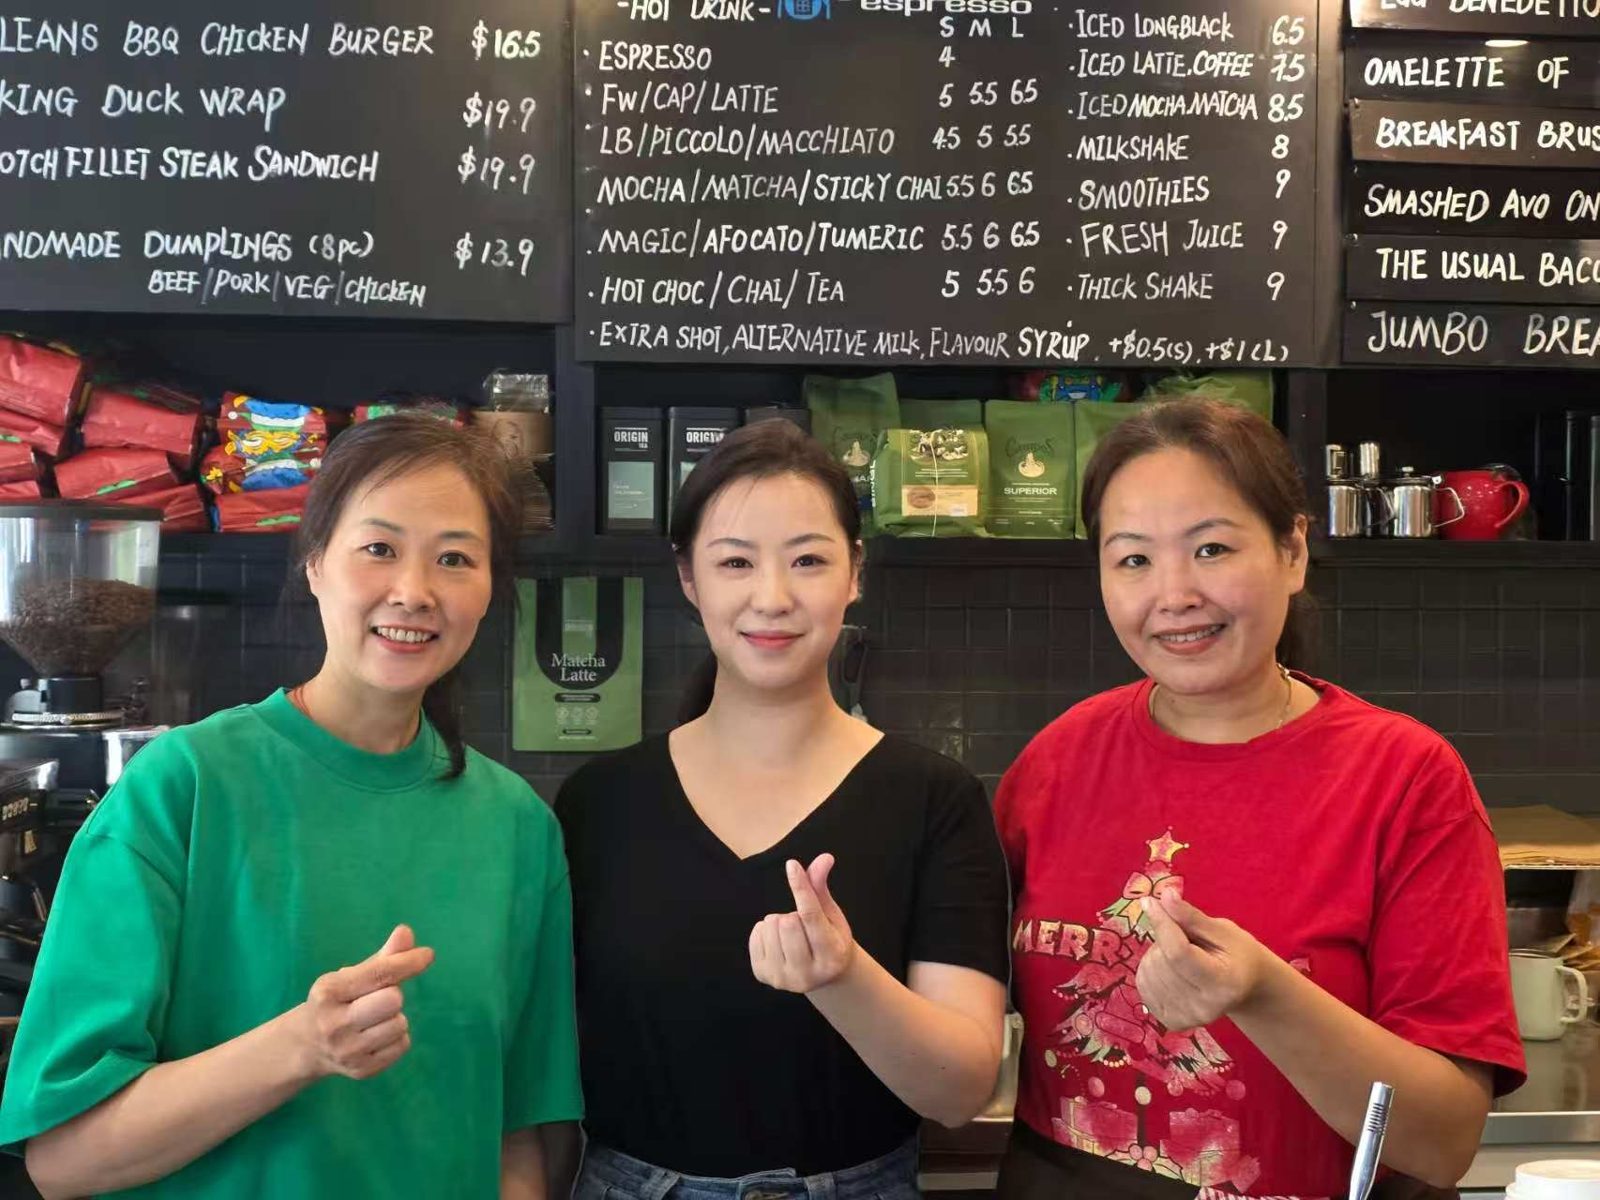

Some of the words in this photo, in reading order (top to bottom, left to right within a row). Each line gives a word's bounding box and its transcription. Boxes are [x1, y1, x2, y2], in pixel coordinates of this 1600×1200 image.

[860, 0, 1032, 16] espresso
[1076, 9, 1125, 38] ICED
[0, 17, 98, 56] LEANS
[123, 20, 179, 56] BBQ
[201, 22, 309, 56] CHICKEN
[328, 22, 434, 56] BURGER
[472, 20, 541, 60] $16.5
[939, 16, 955, 38] S
[969, 18, 992, 37] M
[1012, 17, 1024, 38] L
[599, 40, 712, 71] ESPRESSO
[938, 46, 956, 67] 4
[1077, 49, 1125, 78] ICED
[1364, 56, 1505, 87] OMELETTE
[1537, 56, 1570, 89] OF
[0, 79, 78, 118] KING
[102, 83, 184, 117] DUCK
[200, 86, 286, 132] WRAP
[463, 92, 536, 133] $19.9
[938, 83, 954, 108] 5
[1077, 91, 1127, 120] ICED
[1267, 94, 1304, 122] 8.5
[976, 125, 993, 148] 5
[1076, 133, 1190, 161] MILKSHAKE
[1271, 134, 1289, 159] 8
[1376, 117, 1521, 150] BREAKFAST
[0, 148, 59, 180] OTCH
[64, 146, 151, 180] FILLET
[159, 147, 239, 179] STEAK
[248, 145, 379, 182] SANDWICH
[458, 146, 536, 194] $19.9
[896, 175, 942, 200] CHAI
[981, 171, 996, 198] 6
[1078, 175, 1209, 211] SMOOTHIES
[1275, 169, 1291, 199] 9
[1364, 184, 1489, 222] SMASHED
[1500, 188, 1550, 220] AVO
[144, 227, 292, 264] DUMPLINGS
[456, 232, 534, 276] $13.9
[941, 223, 973, 251] 5.5
[983, 221, 1000, 249] 6
[1081, 221, 1169, 257] FRESH
[1183, 219, 1244, 251] JUICE
[1272, 220, 1288, 250] 9
[1376, 248, 1428, 281] THE
[1441, 251, 1525, 281] USUAL
[601, 276, 645, 304] HOT
[941, 270, 960, 298] 5
[1018, 266, 1036, 294] 6
[1079, 273, 1137, 300] THICK
[1145, 272, 1213, 300] SHAKE
[1266, 272, 1285, 301] 9
[600, 321, 669, 349] EXTRA
[732, 323, 867, 356] ALTERNATIVE
[929, 327, 1010, 359] FLAVOUR
[1367, 310, 1488, 355] JUMBO
[614, 431, 649, 443] ORIGIN
[1003, 487, 1058, 496] SUPERIOR
[551, 653, 606, 668] Matcha
[560, 667, 597, 682] Latte
